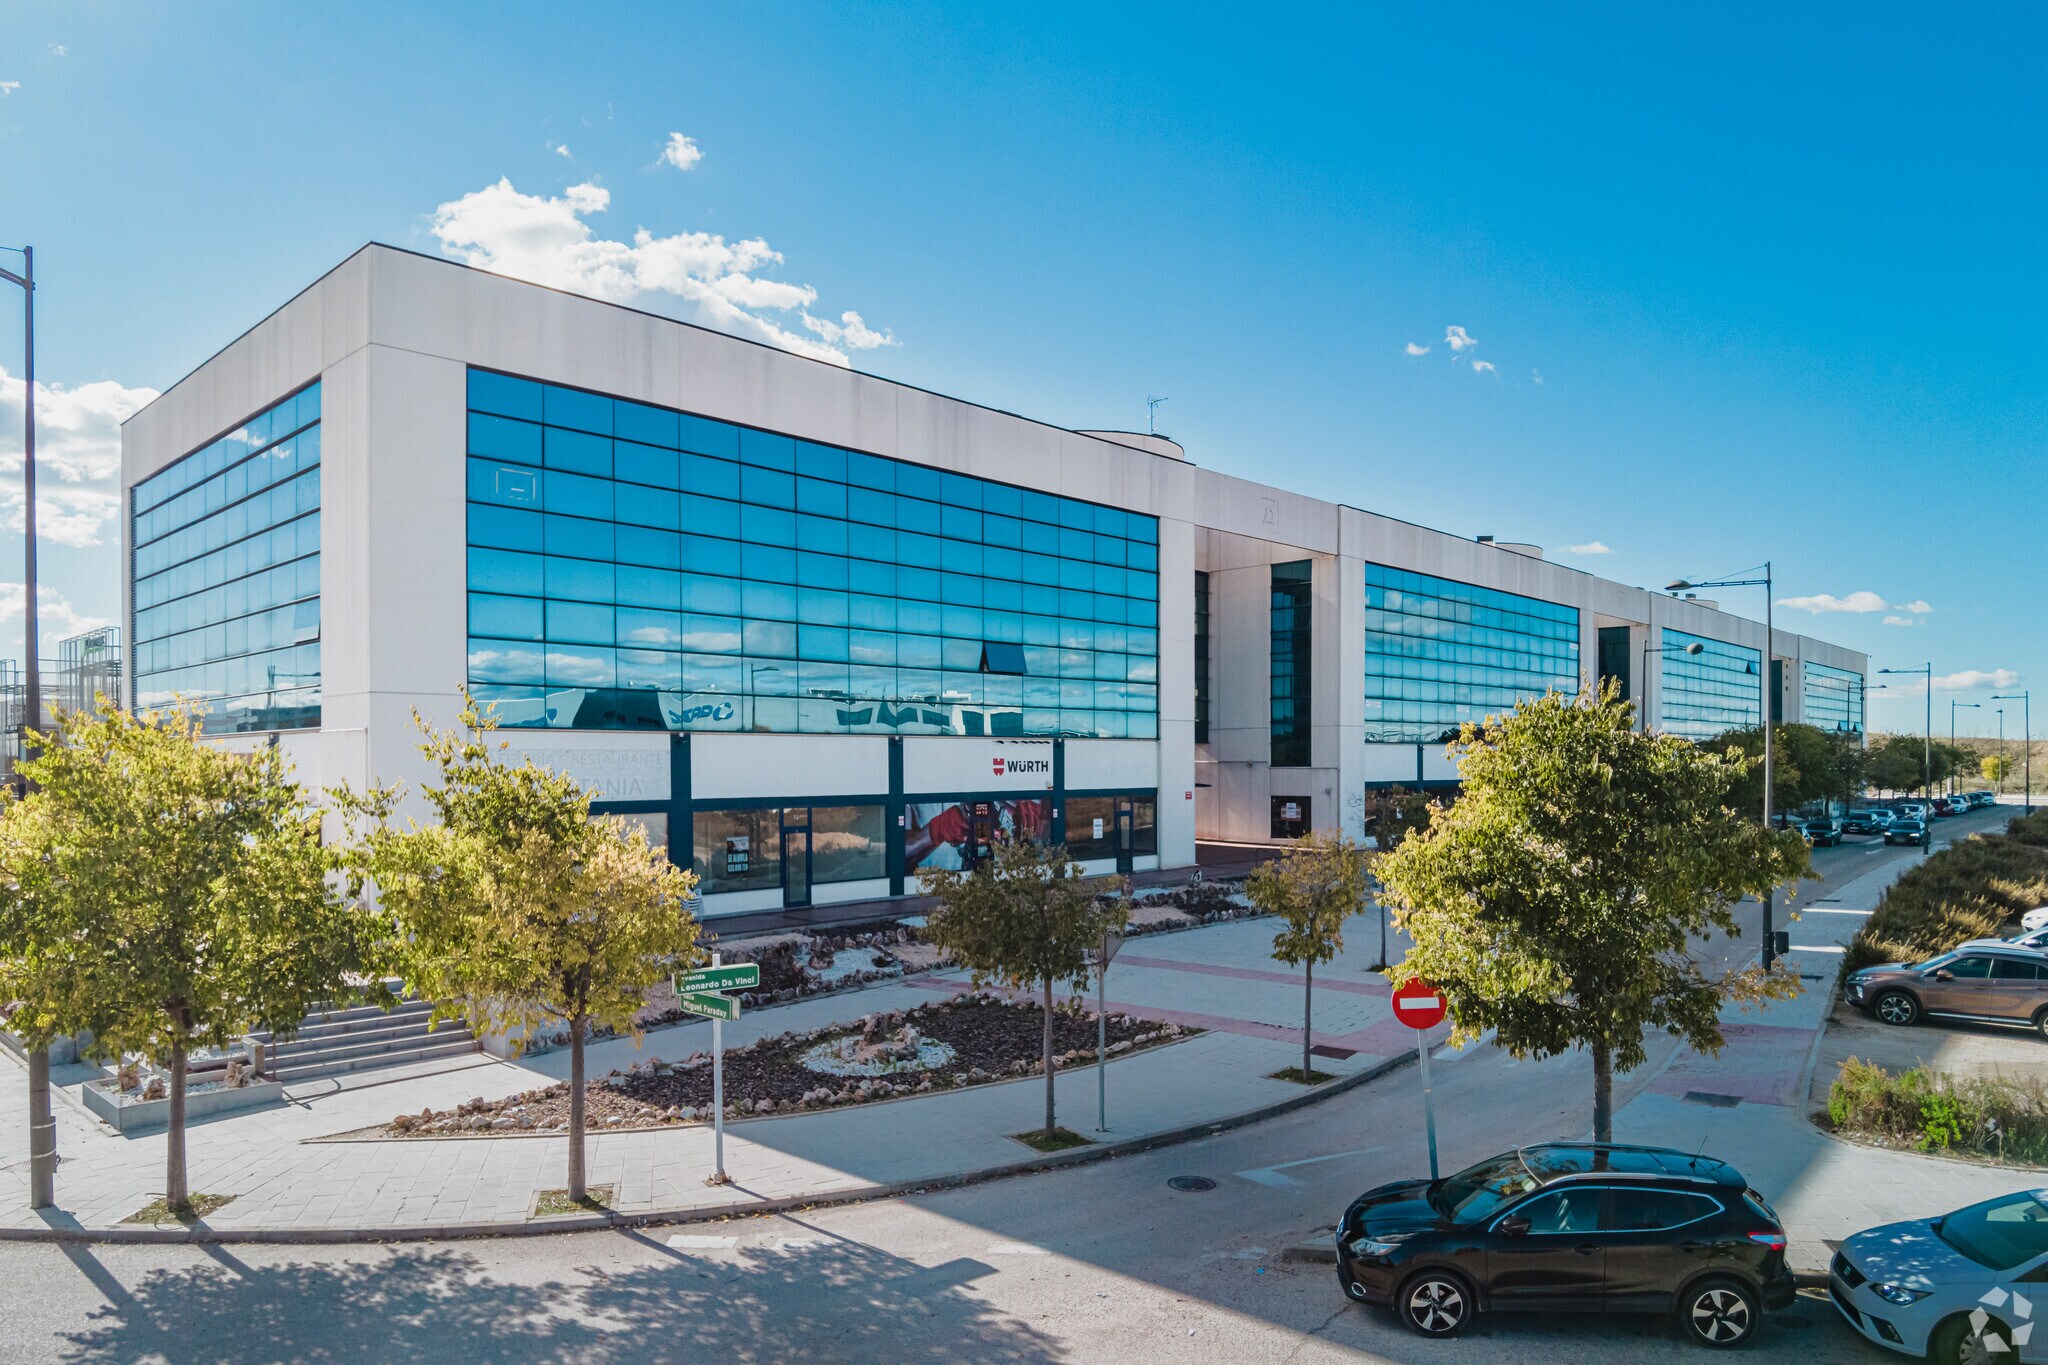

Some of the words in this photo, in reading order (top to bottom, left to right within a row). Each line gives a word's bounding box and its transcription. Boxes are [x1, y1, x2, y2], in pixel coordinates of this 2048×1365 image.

[571, 753, 663, 765] RESTAURANTE
[1007, 761, 1049, 773] WÜRTH
[578, 777, 643, 796] TANIA
[681, 981, 720, 992] Leonardo
[721, 979, 733, 987] Da
[735, 976, 755, 985] Vinci
[683, 1001, 702, 1011] Miguel
[703, 1004, 727, 1018] Faraday
